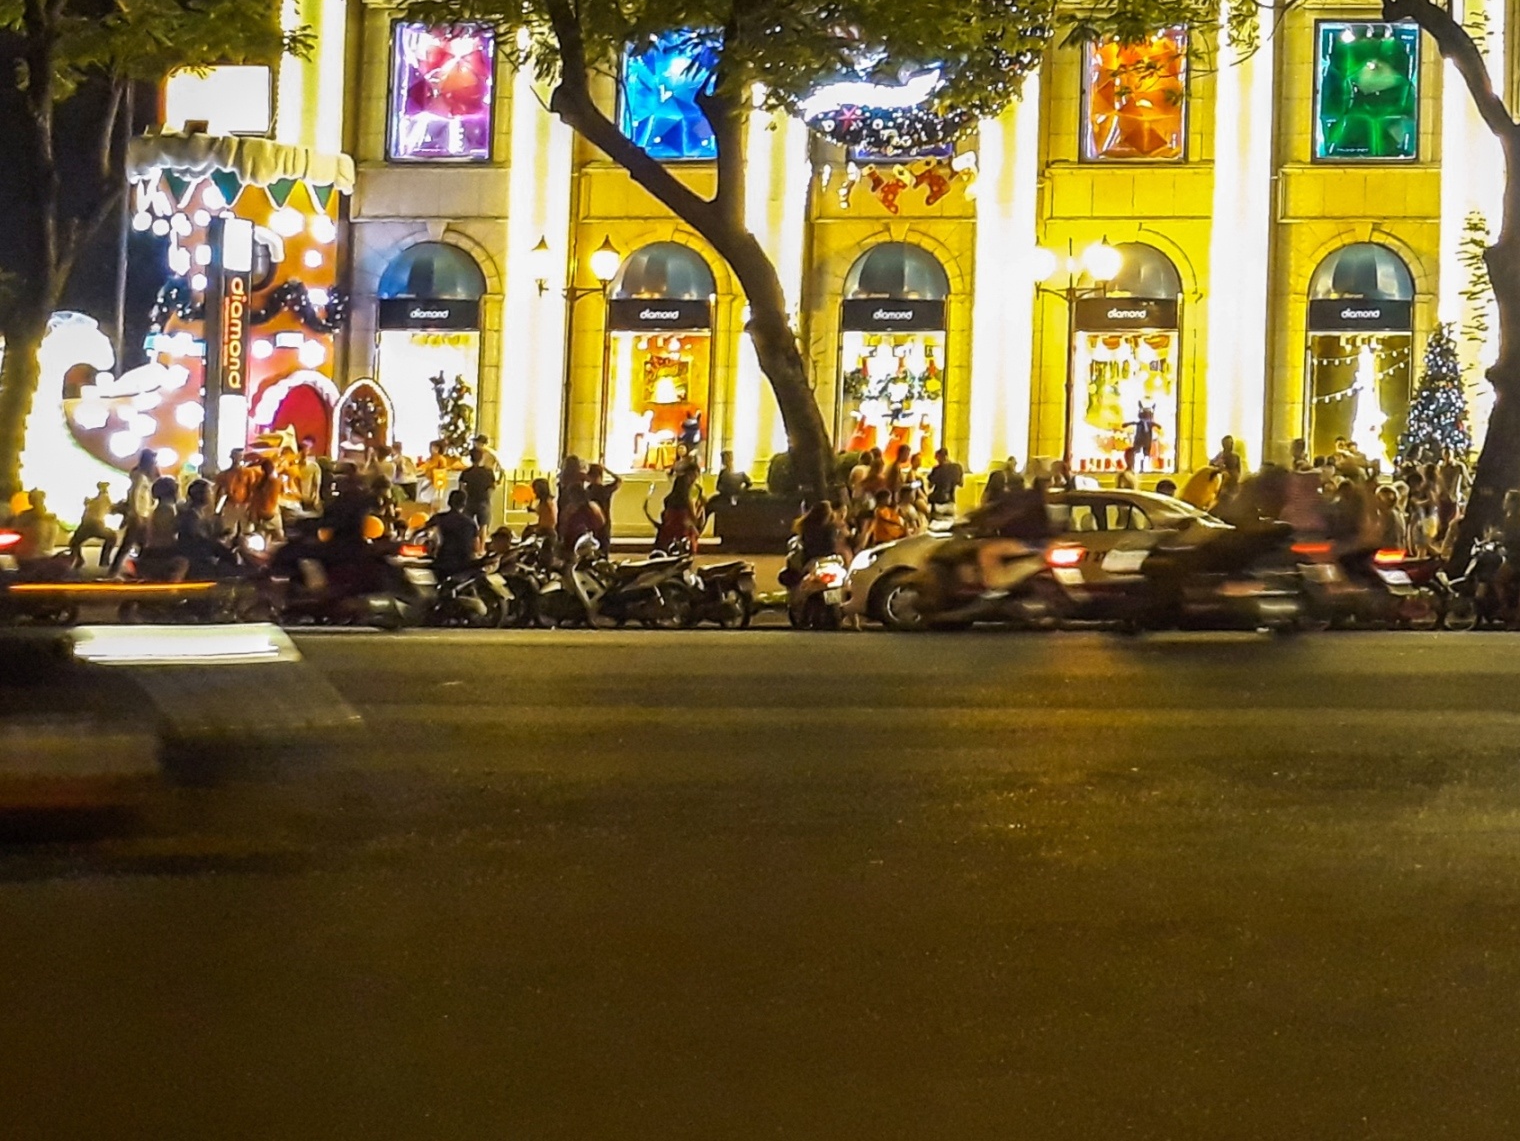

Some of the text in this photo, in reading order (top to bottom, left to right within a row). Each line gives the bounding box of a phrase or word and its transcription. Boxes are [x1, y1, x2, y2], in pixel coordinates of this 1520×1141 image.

[410, 307, 449, 319] diamond
[640, 308, 679, 320] diamond
[872, 308, 913, 320] diamond
[1107, 307, 1146, 319] diamond
[1341, 307, 1381, 319] diamond
[228, 276, 247, 389] diamond
